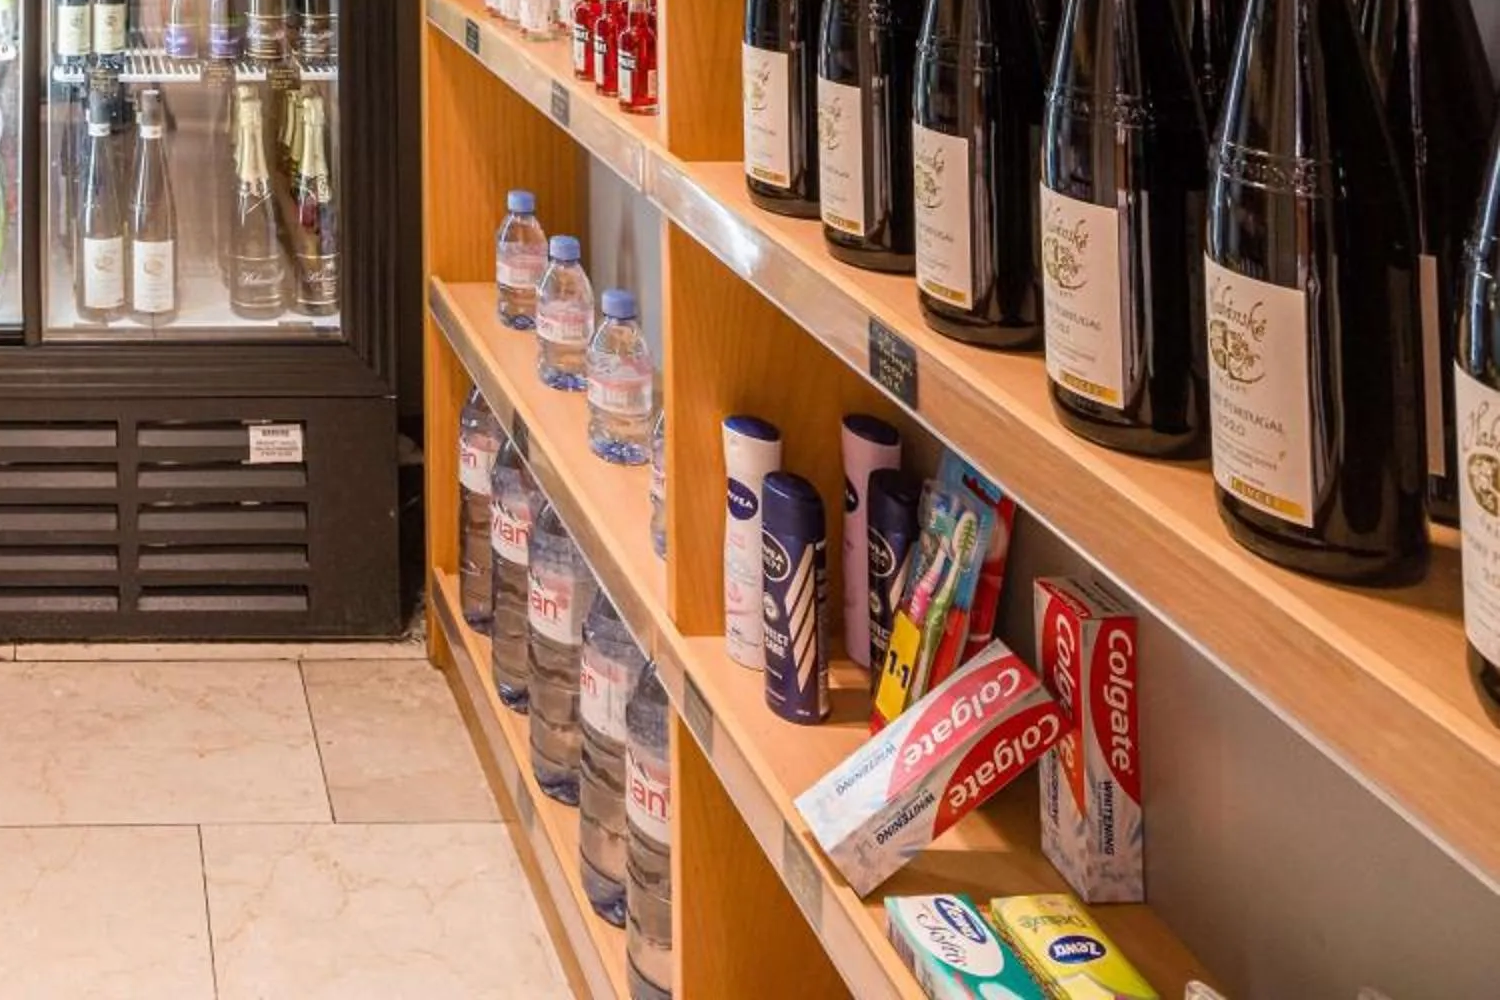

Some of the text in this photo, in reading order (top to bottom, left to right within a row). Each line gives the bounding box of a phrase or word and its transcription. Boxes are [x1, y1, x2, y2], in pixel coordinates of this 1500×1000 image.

[493, 520, 530, 546] ian
[904, 667, 1021, 767] Colgate
[1104, 628, 1134, 772] Colgate
[950, 713, 1060, 809] Colgate
[631, 780, 668, 820] ian
[876, 792, 937, 847] WHITENING
[1103, 780, 1115, 857] WHITENING
